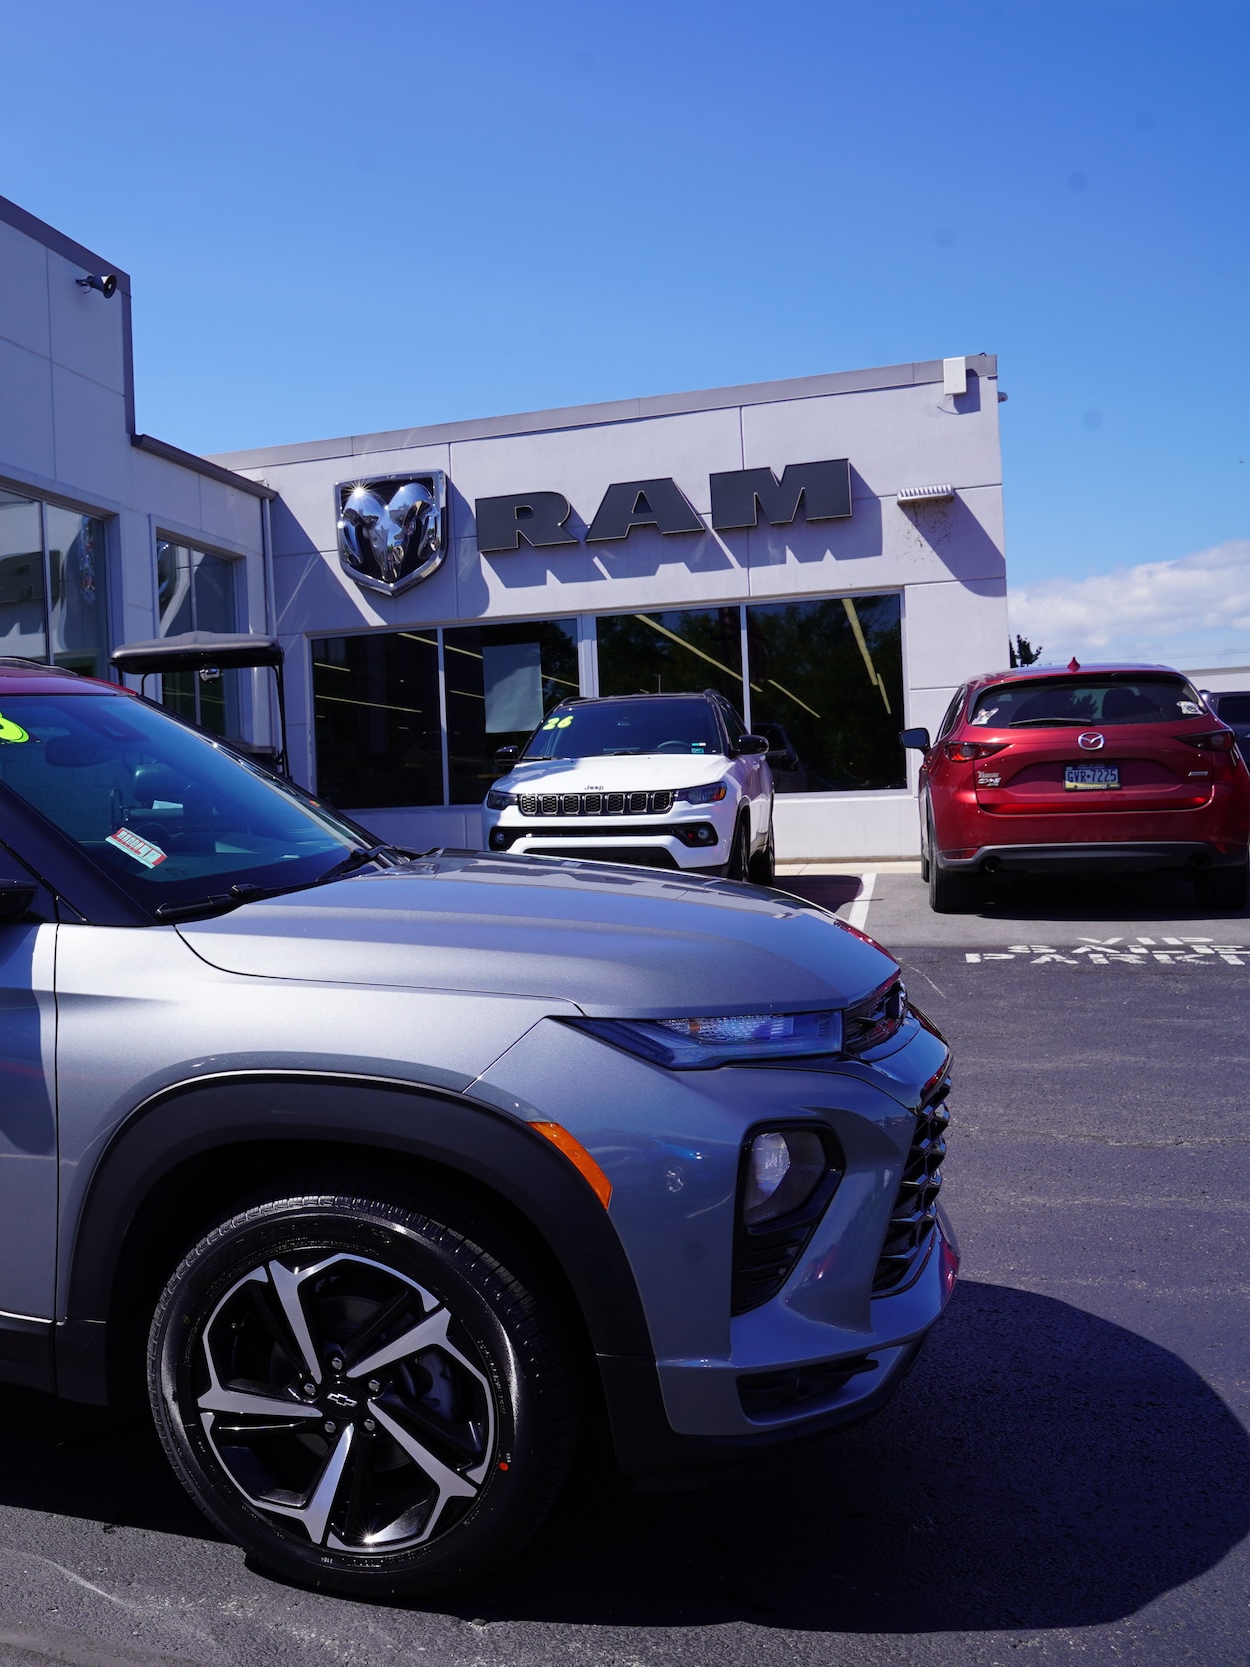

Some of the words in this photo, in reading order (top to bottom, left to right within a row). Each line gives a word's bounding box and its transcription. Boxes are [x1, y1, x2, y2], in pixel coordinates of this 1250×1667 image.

[475, 458, 853, 552] RAM
[542, 715, 574, 731] 26
[1077, 937, 1214, 945] VIP
